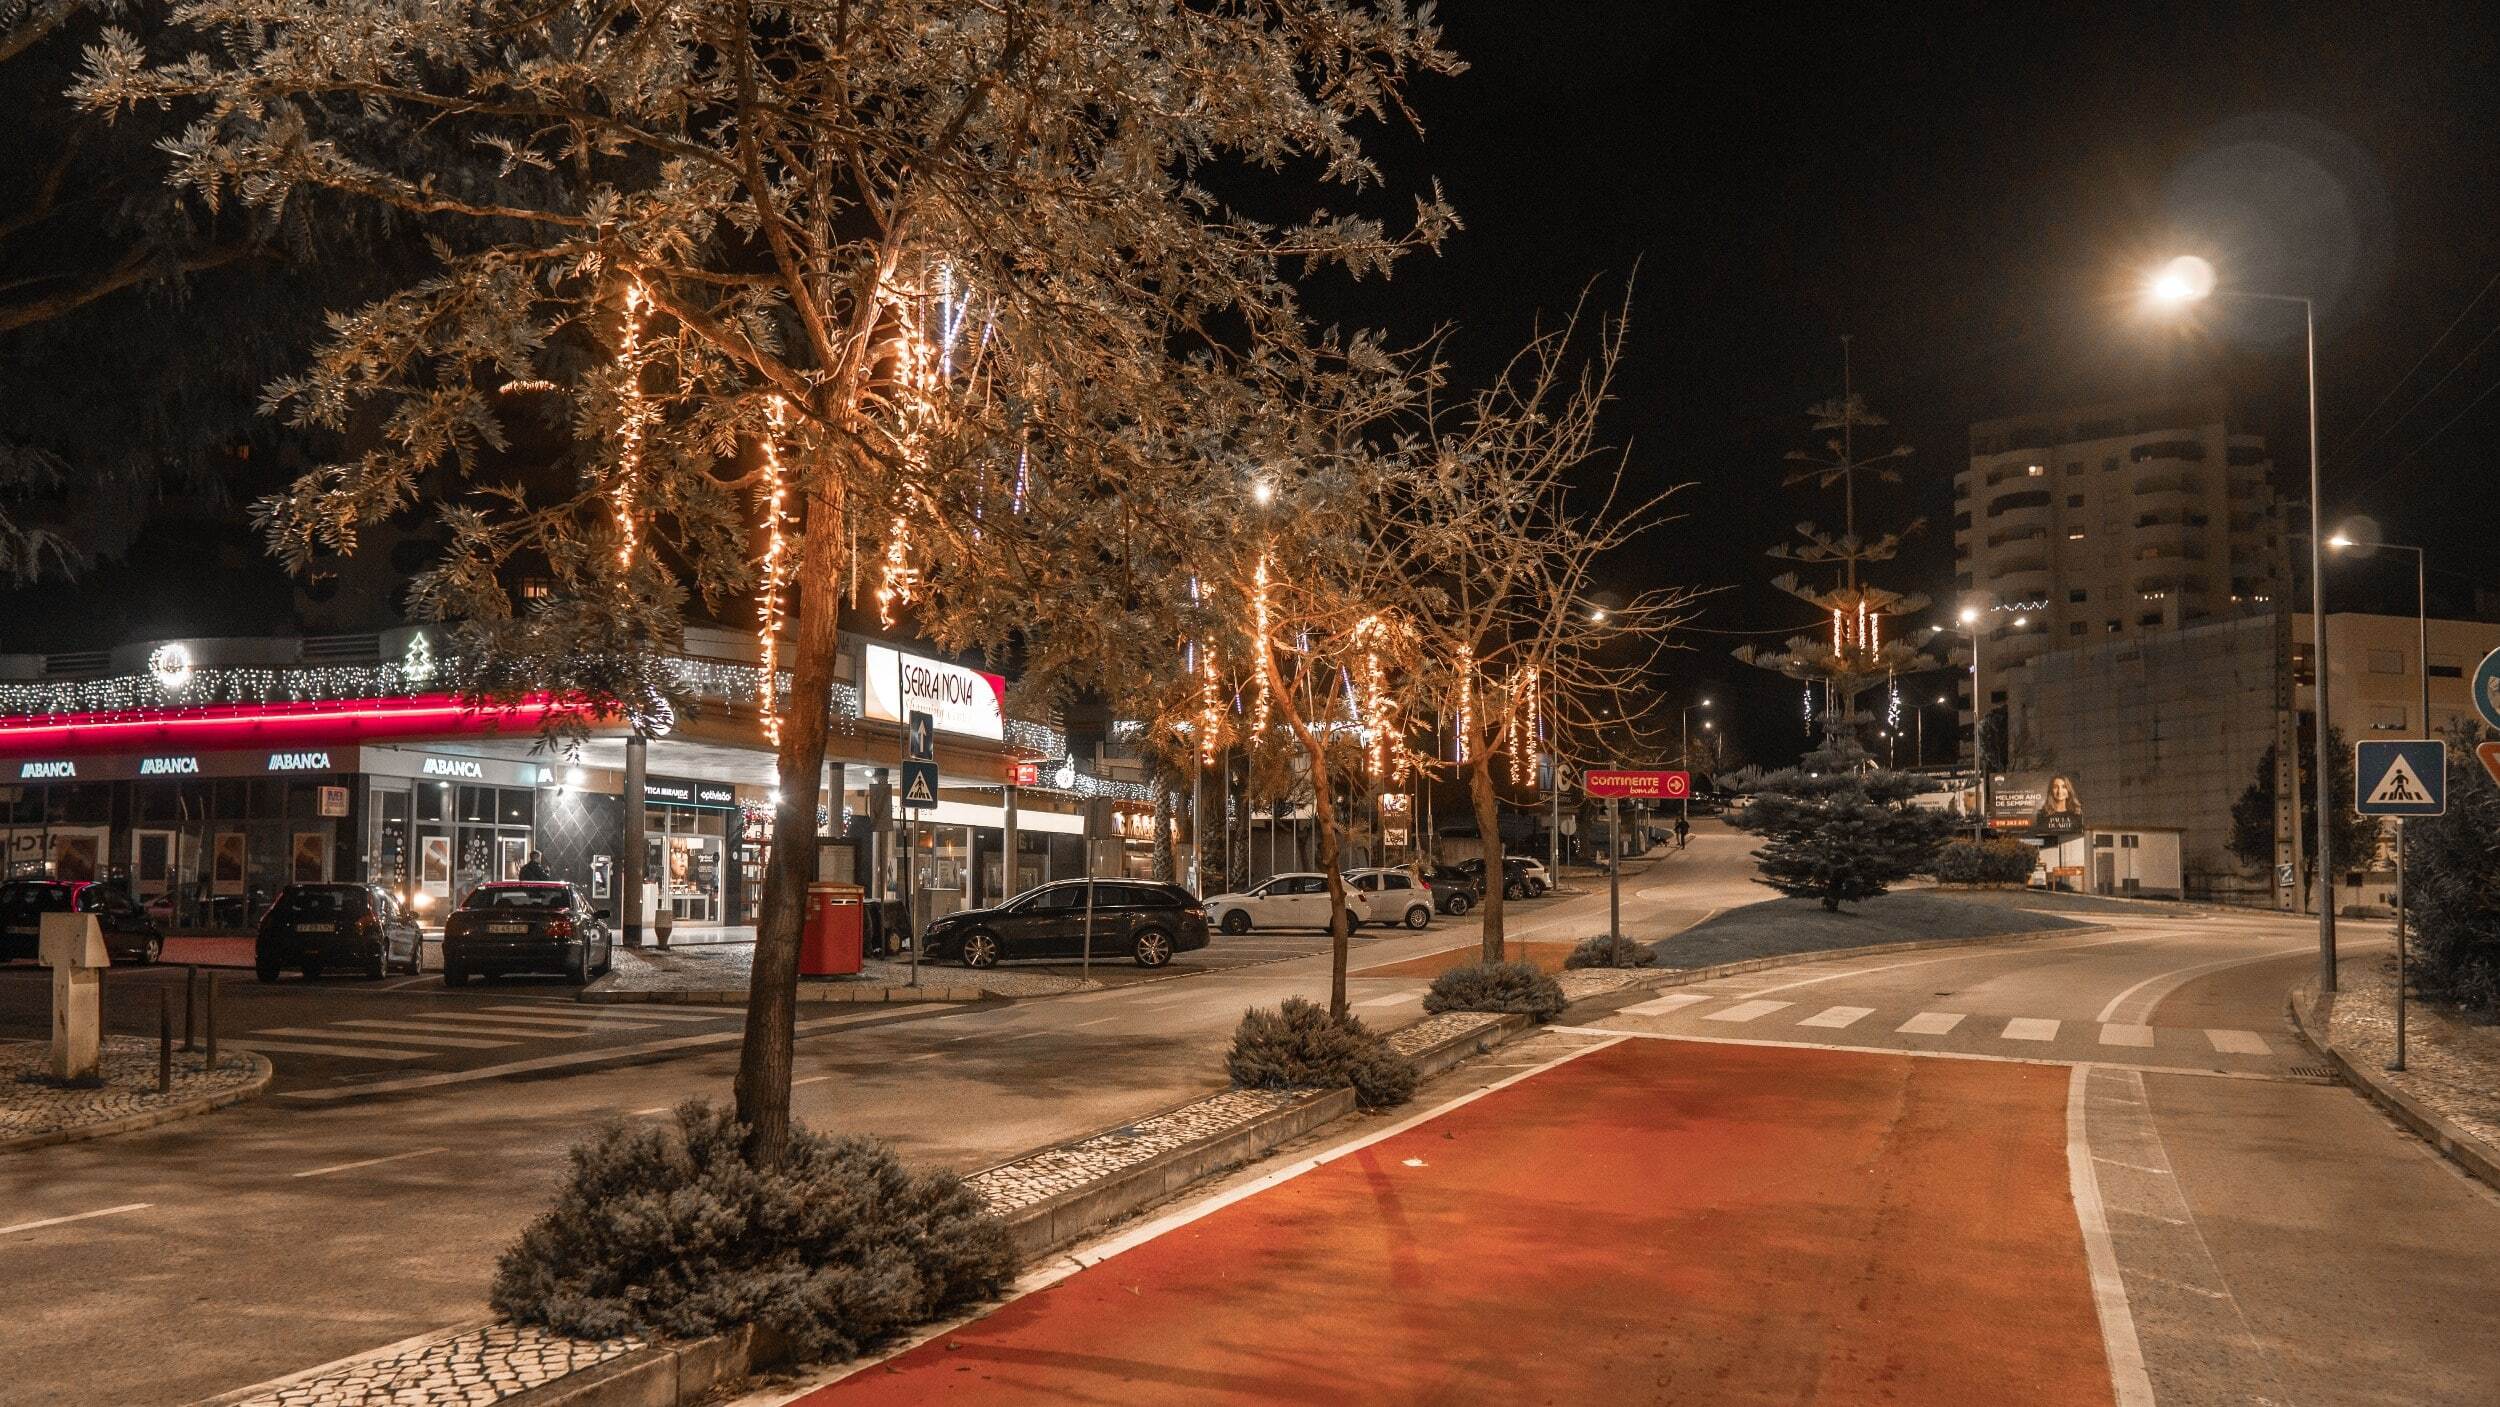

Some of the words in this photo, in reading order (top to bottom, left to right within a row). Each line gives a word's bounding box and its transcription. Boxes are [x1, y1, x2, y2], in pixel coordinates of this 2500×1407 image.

[904, 665, 939, 699] SERRA
[942, 671, 973, 706] NOVA
[140, 757, 199, 774] ABANCA
[268, 752, 331, 770] ABANCA
[422, 758, 483, 778] ABANCA
[21, 762, 76, 778] ABANCA
[1590, 776, 1659, 786] CONTINENTE
